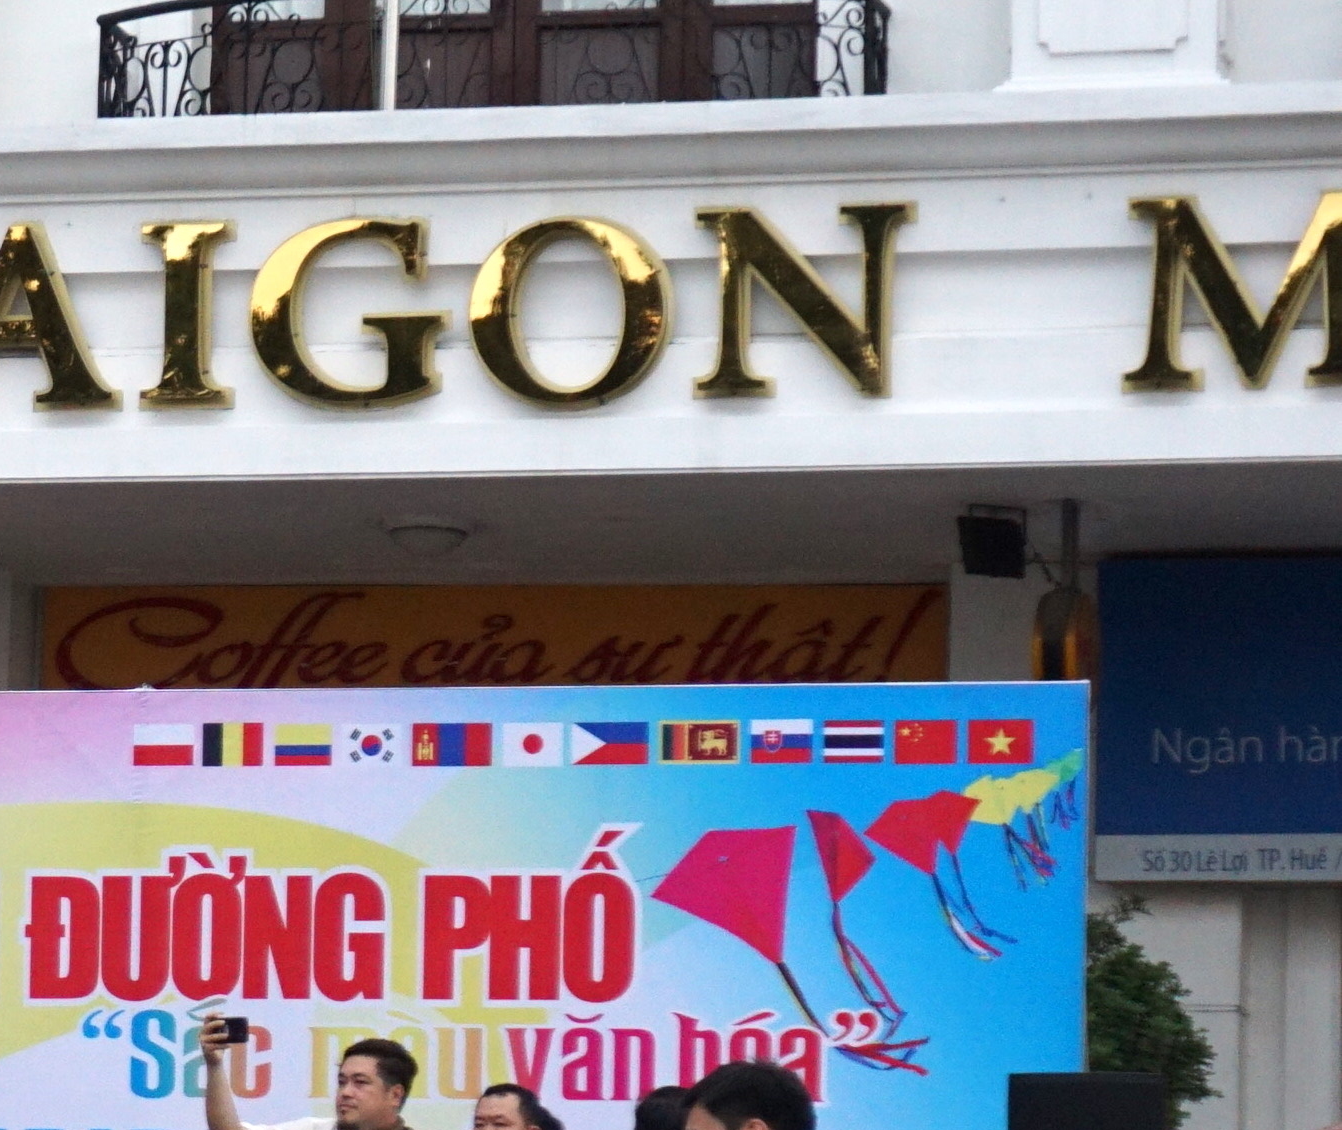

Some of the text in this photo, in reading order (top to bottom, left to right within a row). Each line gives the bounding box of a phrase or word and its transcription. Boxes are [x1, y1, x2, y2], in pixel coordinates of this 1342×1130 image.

[57, 592, 387, 688] Coffee
[403, 613, 554, 686] của
[1150, 727, 1264, 774] Ngân
[1170, 850, 1192, 873] 30
[1257, 848, 1285, 872] TP.
[25, 850, 385, 1003] ĐƯỜNG
[424, 830, 639, 1003] PHỐ
[503, 1013, 656, 1101] văn
